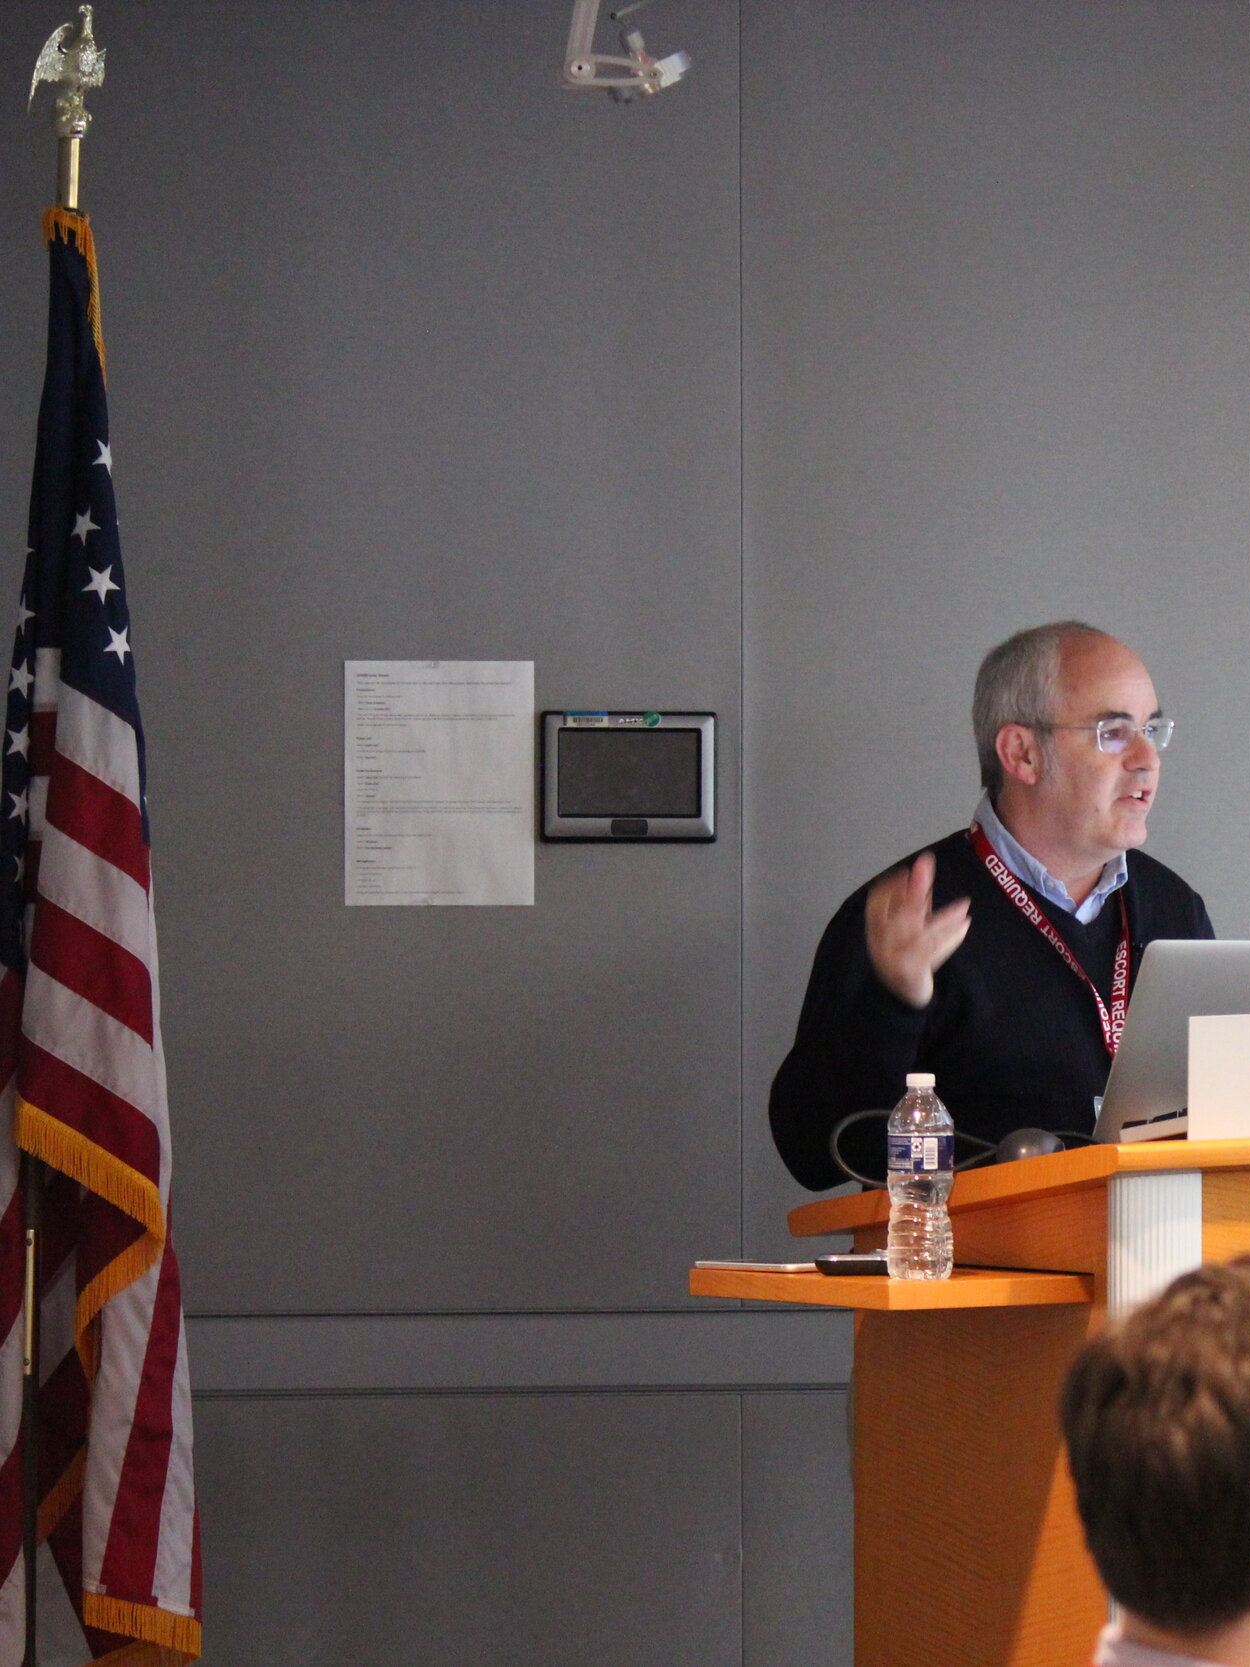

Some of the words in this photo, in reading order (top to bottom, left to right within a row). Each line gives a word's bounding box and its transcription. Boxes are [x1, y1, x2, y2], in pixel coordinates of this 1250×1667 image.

[985, 854, 1042, 926] REQUIRED
[1112, 940, 1127, 996] ESCORT
[1111, 999, 1126, 1054] REQU
